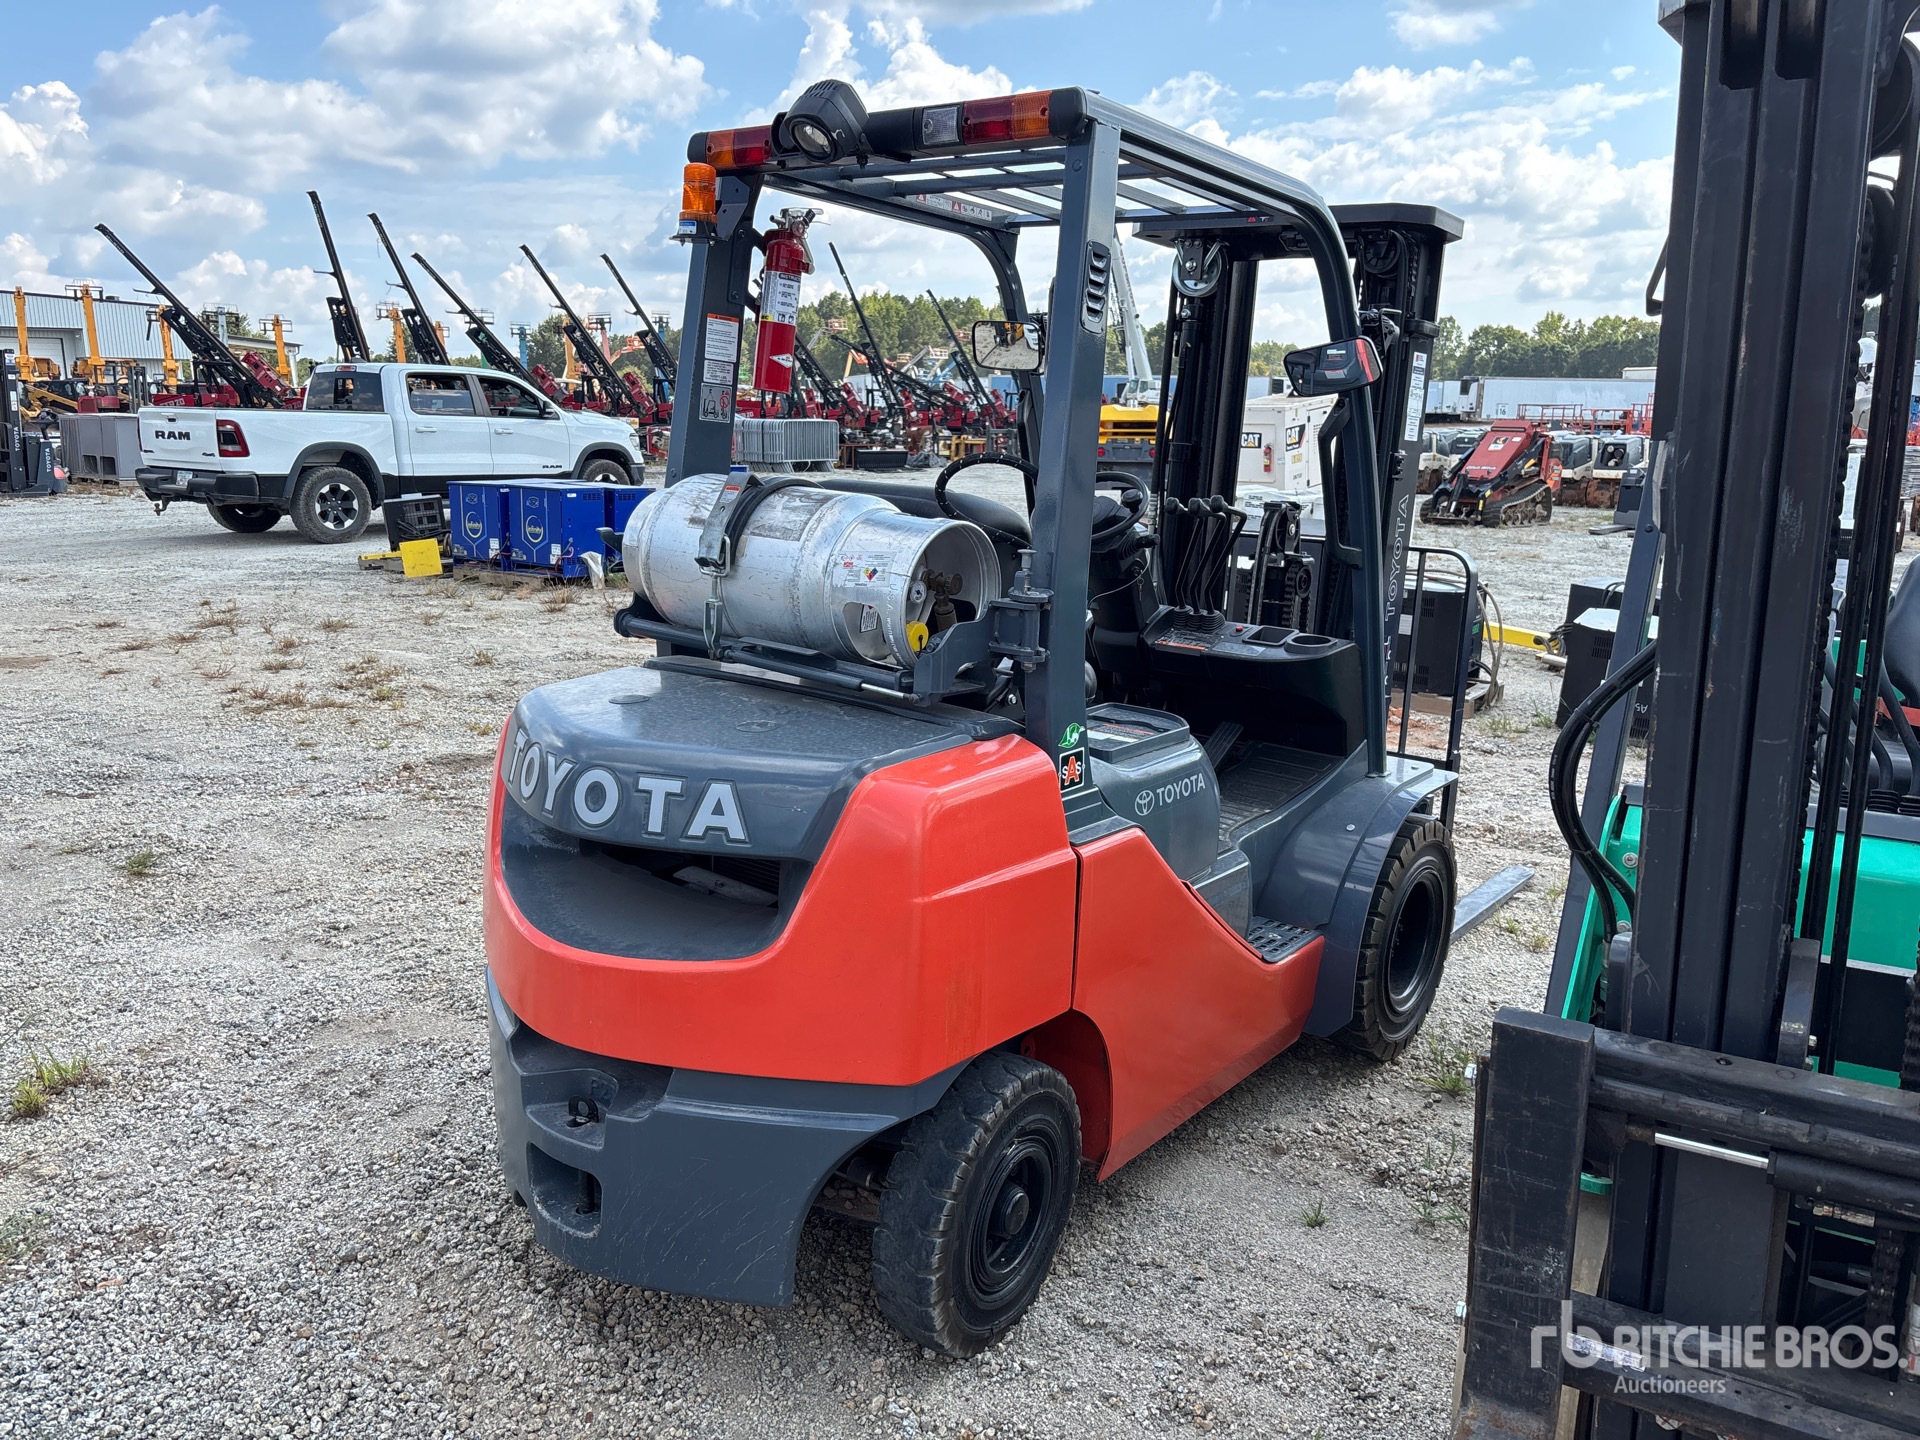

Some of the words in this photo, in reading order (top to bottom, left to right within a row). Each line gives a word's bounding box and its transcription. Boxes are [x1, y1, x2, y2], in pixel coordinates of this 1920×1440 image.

[155, 430, 191, 441] RAM
[1241, 433, 1260, 447] CAT
[1287, 425, 1300, 446] CAT
[1385, 494, 1410, 622] TOYOTA
[508, 730, 748, 842] TOYOTA
[1061, 755, 1083, 786] SAS
[1156, 772, 1206, 807] TOYOTA
